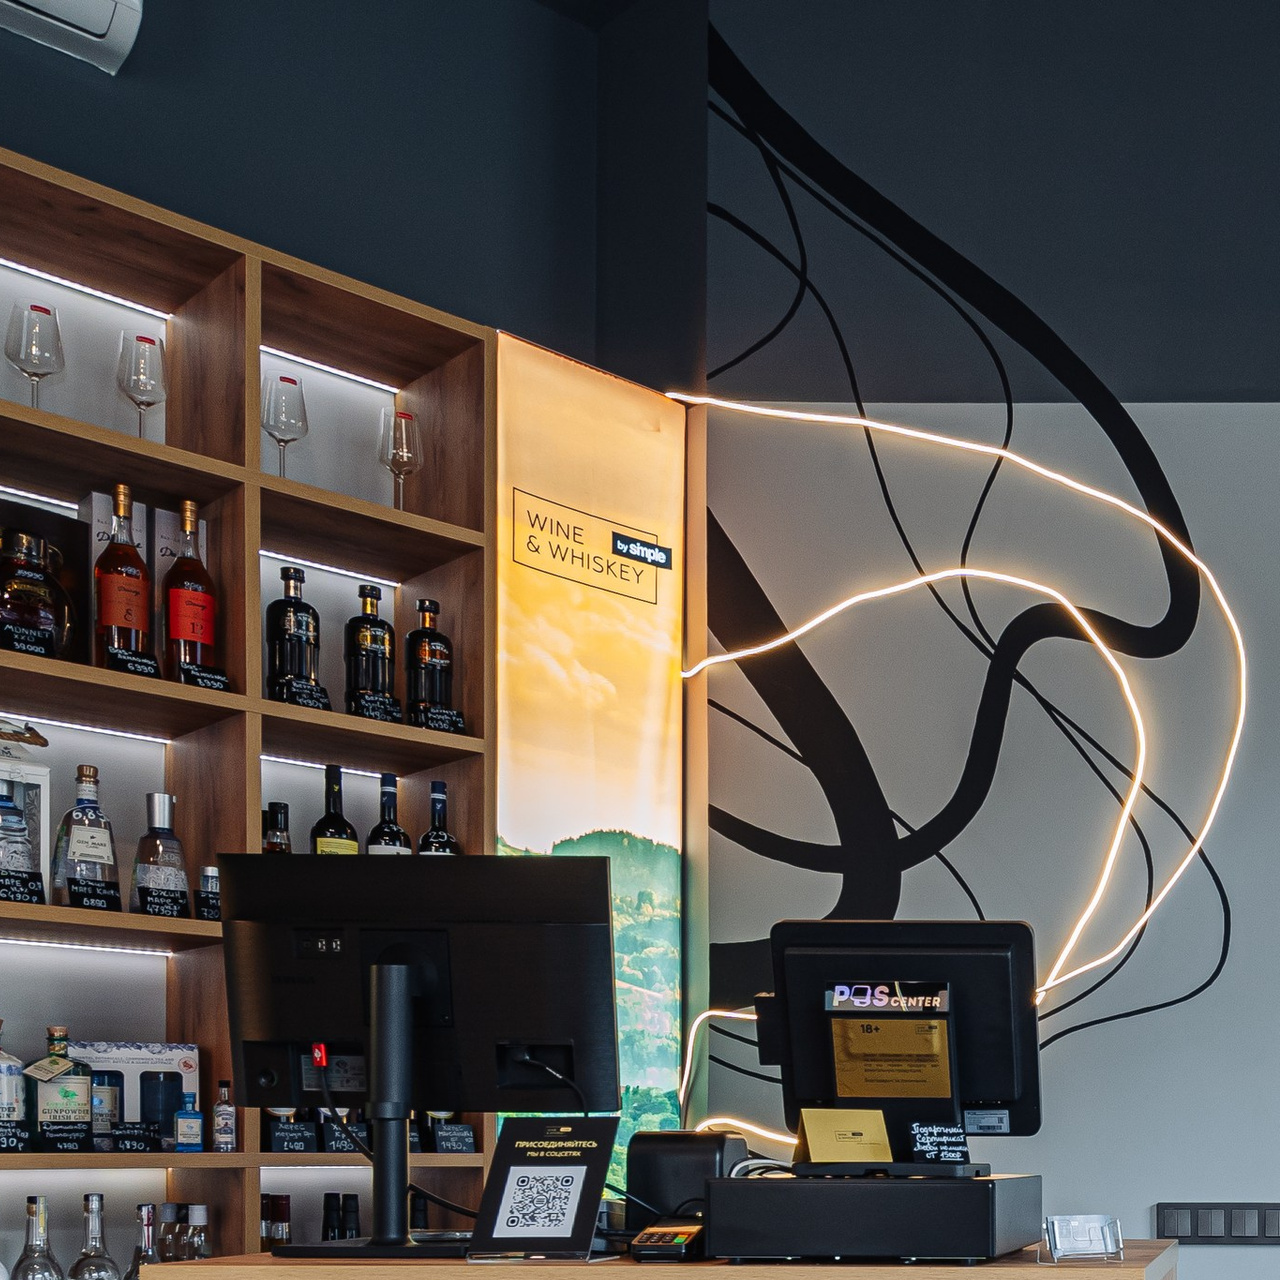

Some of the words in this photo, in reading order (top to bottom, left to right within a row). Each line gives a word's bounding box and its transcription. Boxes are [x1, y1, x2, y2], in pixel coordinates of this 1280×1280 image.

[526, 509, 584, 545] WINE
[526, 535, 540, 555] &
[548, 540, 645, 585] WHISKEY
[616, 539, 628, 553] by
[628, 542, 667, 563] simple
[833, 985, 890, 1007] POS
[890, 997, 941, 1008] CENTER
[860, 1023, 880, 1034] 18+
[515, 1140, 598, 1149] ПРИСОЕДИНЯЙТЕСЬ
